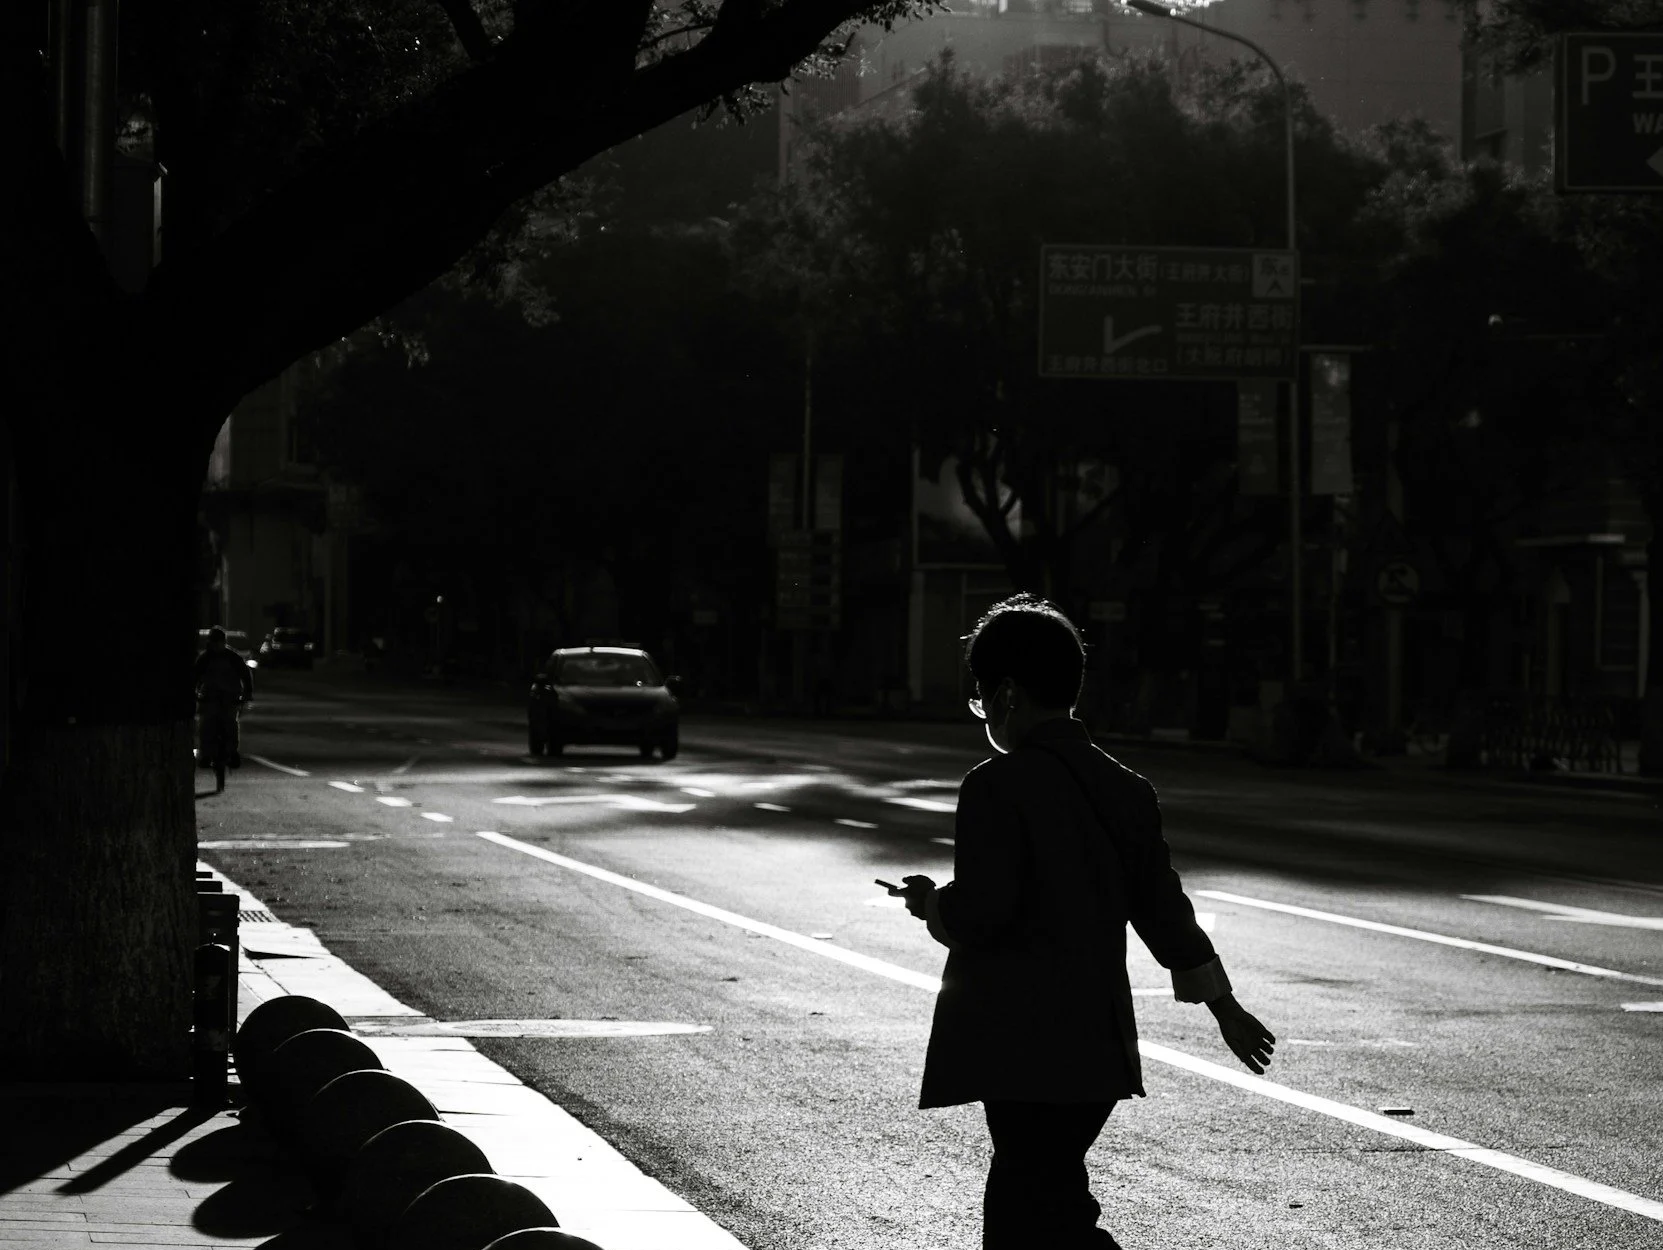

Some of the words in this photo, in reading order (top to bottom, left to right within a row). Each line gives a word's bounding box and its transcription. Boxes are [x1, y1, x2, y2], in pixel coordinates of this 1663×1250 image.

[1582, 45, 1617, 106] P
[1047, 252, 1159, 281] 东安门大街
[1175, 302, 1294, 331] 王府井西街
